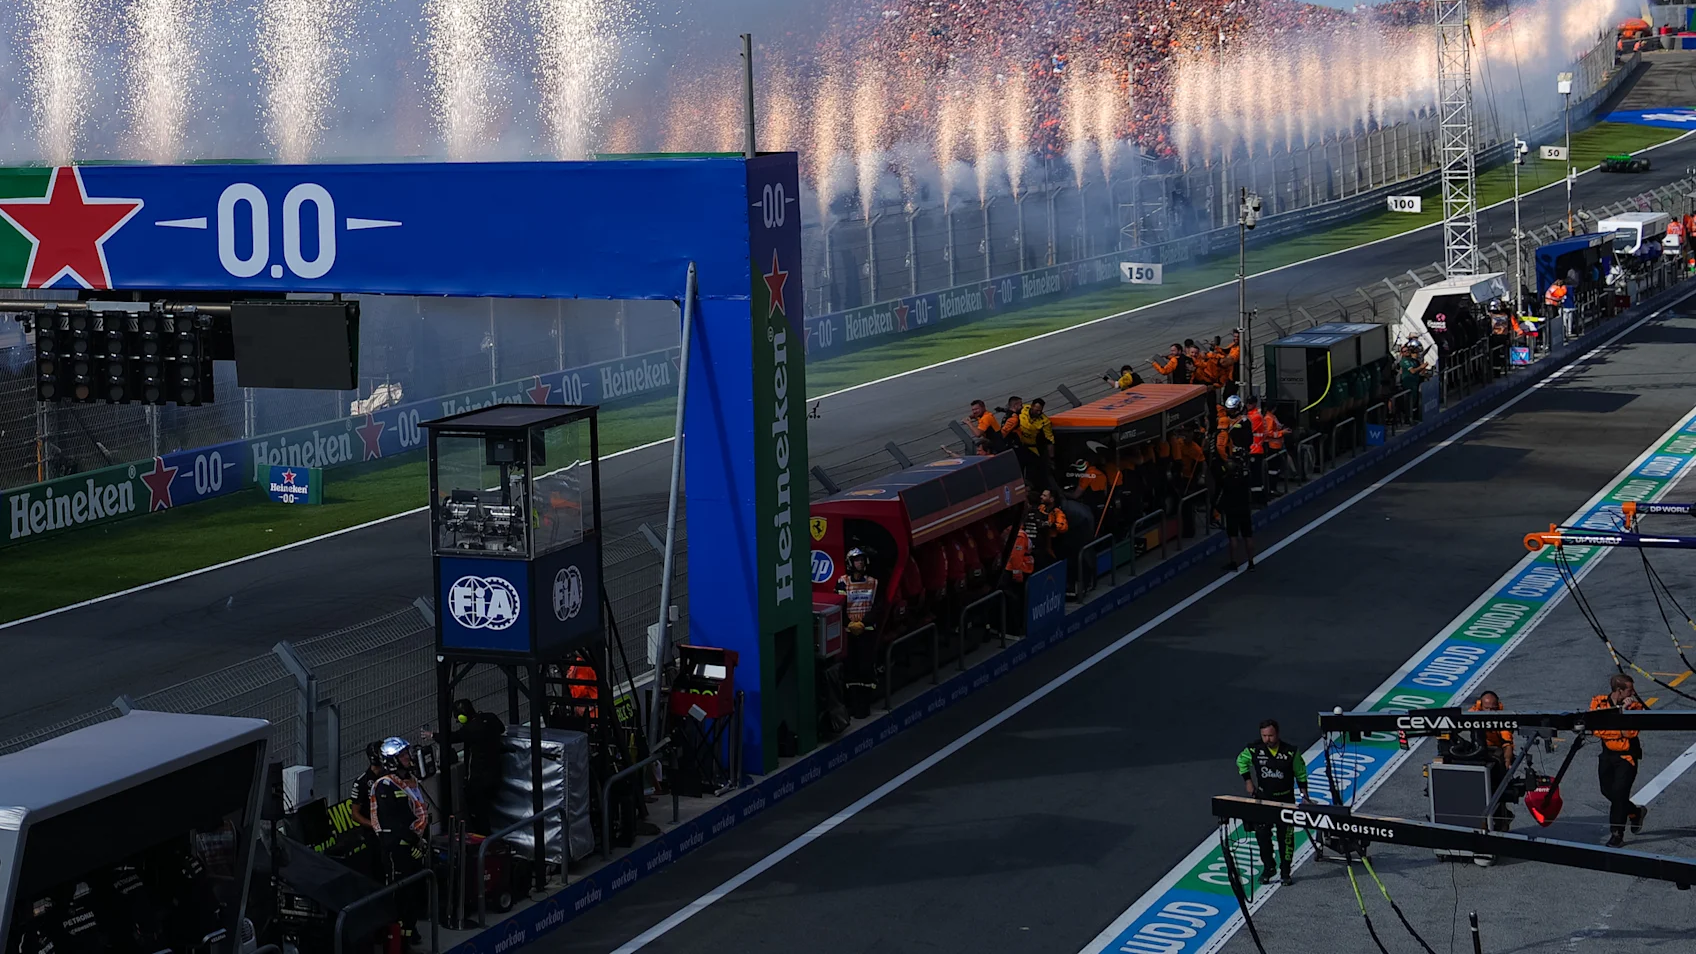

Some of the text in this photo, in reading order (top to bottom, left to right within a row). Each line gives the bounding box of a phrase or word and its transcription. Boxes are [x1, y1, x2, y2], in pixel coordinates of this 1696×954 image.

[1547, 149, 1560, 157] 50
[762, 182, 785, 229] 0.0
[1393, 199, 1414, 210] 100
[216, 182, 336, 279] 0.0
[1022, 271, 1061, 299] Heineken
[1128, 266, 1154, 280] 150
[1001, 279, 1013, 303] 0.0
[915, 304, 929, 323] 0.0
[939, 290, 983, 321] Heineken
[818, 319, 833, 347] 0.0
[845, 310, 894, 343] Heineken
[562, 372, 583, 405] 0.0
[600, 358, 671, 400] Heineken
[398, 409, 422, 447] 0.0
[1369, 430, 1382, 439] W
[252, 430, 354, 483] Heineken
[771, 328, 795, 607] Heineken
[195, 451, 223, 495] 0.0
[270, 481, 308, 494] Heineken
[282, 494, 295, 504] 0.0
[10, 478, 136, 540] Heineken
[811, 554, 827, 576] hp
[1031, 591, 1062, 622] workday
[1463, 602, 1530, 639] aramco
[1412, 645, 1487, 687] aramco
[1457, 720, 1519, 729] LOGISTICS
[827, 752, 848, 769] workday
[800, 765, 822, 784] workday
[1260, 766, 1285, 780] Stake
[773, 781, 795, 800] workday
[743, 797, 766, 817] workday
[712, 813, 736, 834] workday
[1336, 822, 1395, 839] LOGISTICS
[679, 831, 704, 852] workday
[646, 848, 673, 871] workday
[611, 867, 639, 891] workday
[574, 887, 602, 911] workday
[535, 908, 566, 932] workday
[494, 927, 527, 954] workday
